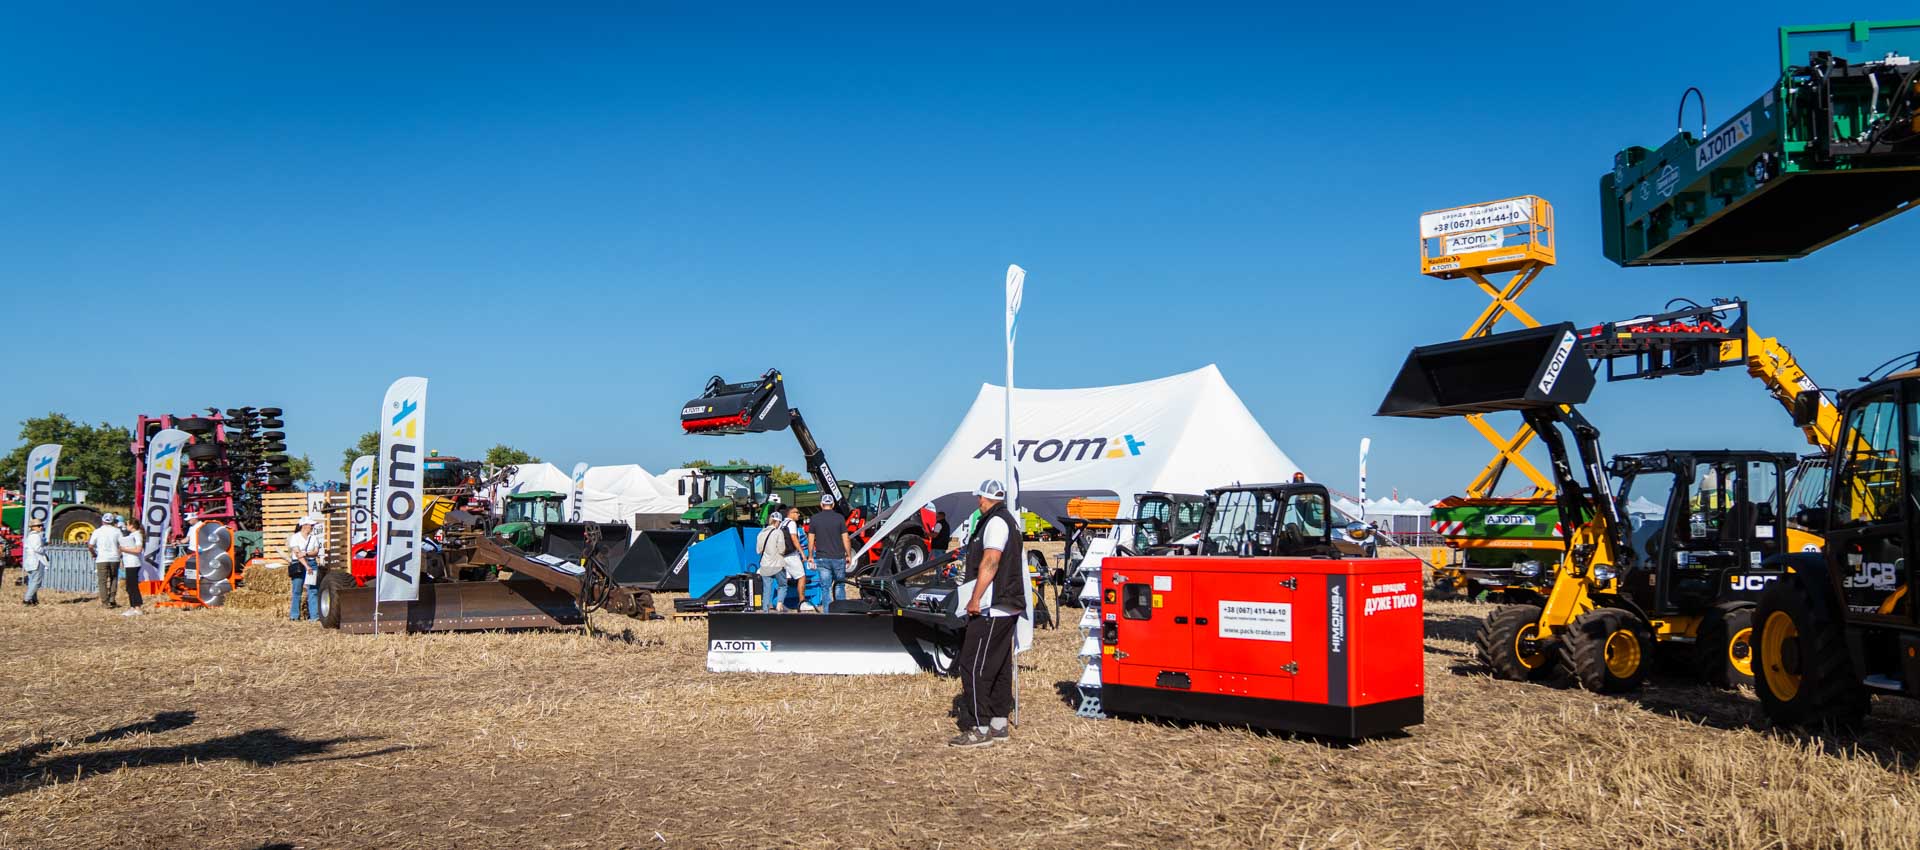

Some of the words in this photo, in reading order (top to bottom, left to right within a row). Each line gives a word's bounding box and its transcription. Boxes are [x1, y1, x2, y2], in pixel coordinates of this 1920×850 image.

[1698, 127, 1737, 167] A.TOM
[1434, 221, 1448, 232] +38
[1450, 219, 1473, 230] (067)
[1475, 211, 1520, 225] 411-44-10
[1452, 235, 1487, 247] A.TOM
[1541, 347, 1568, 391] A.TOM
[821, 465, 836, 491] A.TOM
[384, 443, 417, 585] A.TOM
[1487, 515, 1522, 524] A.TOM
[1236, 606, 1253, 615] (067)
[1254, 607, 1286, 616] 411-44-10
[1364, 596, 1392, 616] ДУЖЕ
[1392, 594, 1417, 609] ТИХО
[1331, 585, 1341, 652] HIMOINSA
[713, 641, 755, 651] A.TOM
